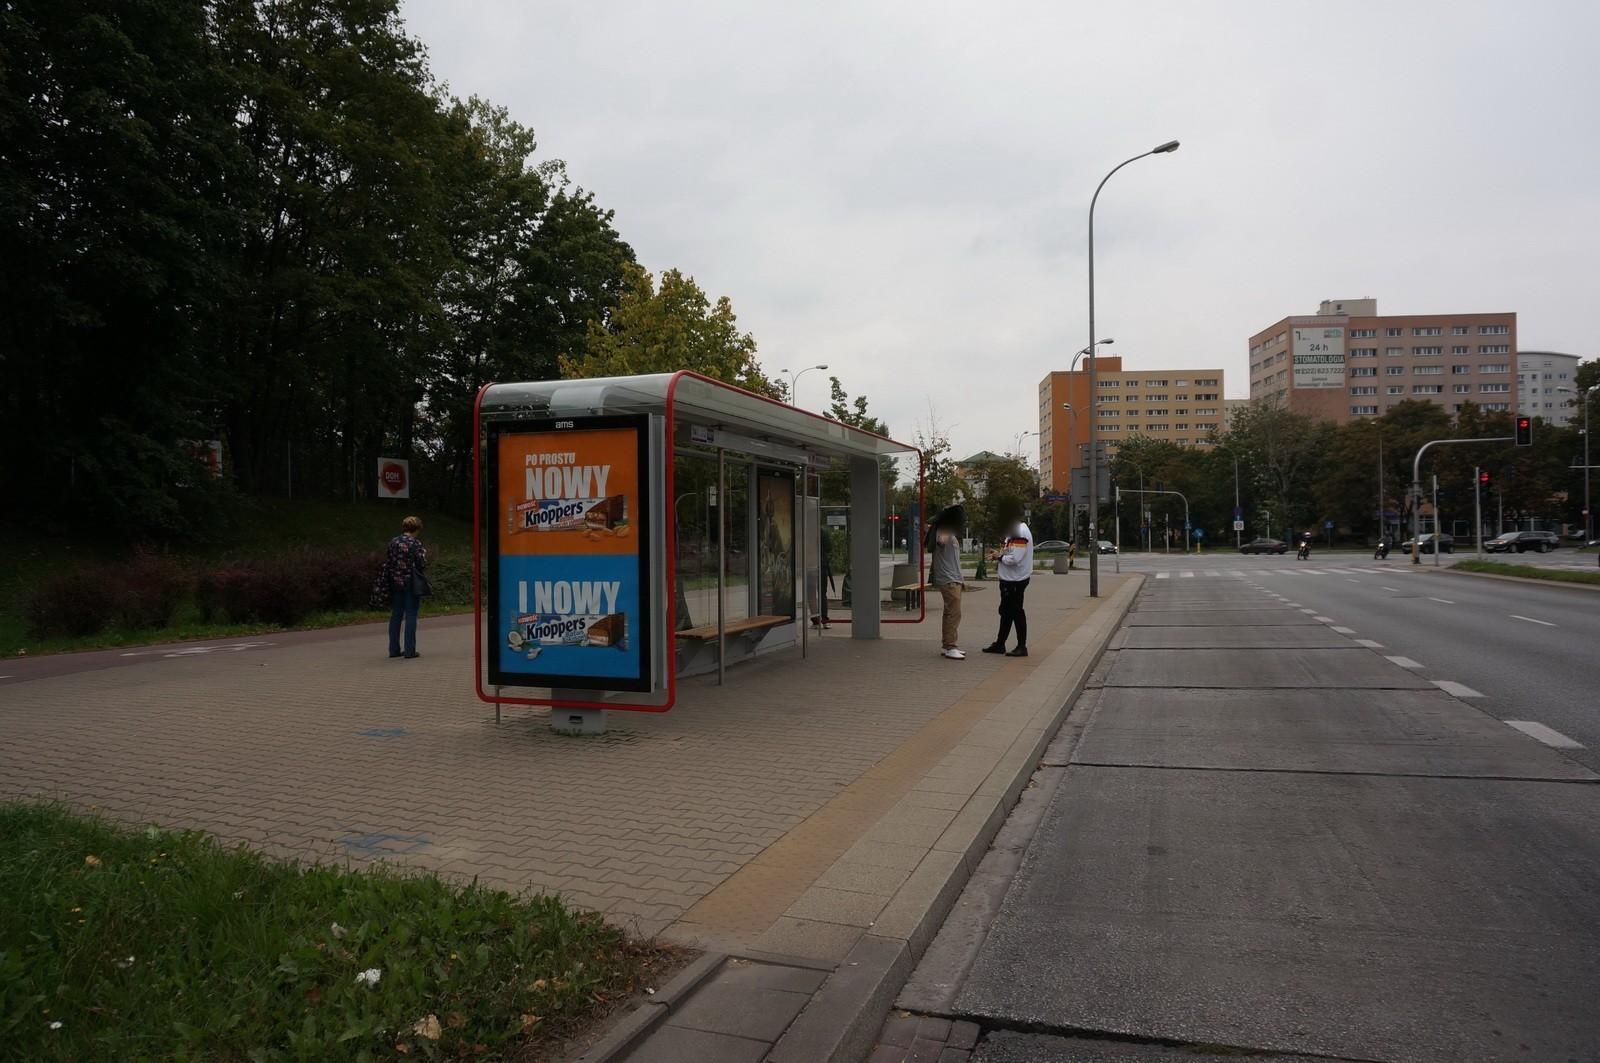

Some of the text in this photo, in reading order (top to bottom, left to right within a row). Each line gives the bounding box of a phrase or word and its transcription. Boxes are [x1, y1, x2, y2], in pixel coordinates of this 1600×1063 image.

[1310, 344, 1320, 352] 24
[1294, 355, 1344, 363] STOMATOLOGIA
[555, 420, 574, 429] ams
[525, 452, 576, 466] PO PROSTU
[525, 464, 611, 500] NOWY
[525, 501, 584, 527] Knoppers
[518, 580, 621, 615] I NOWY
[526, 617, 586, 640] Knoppers
